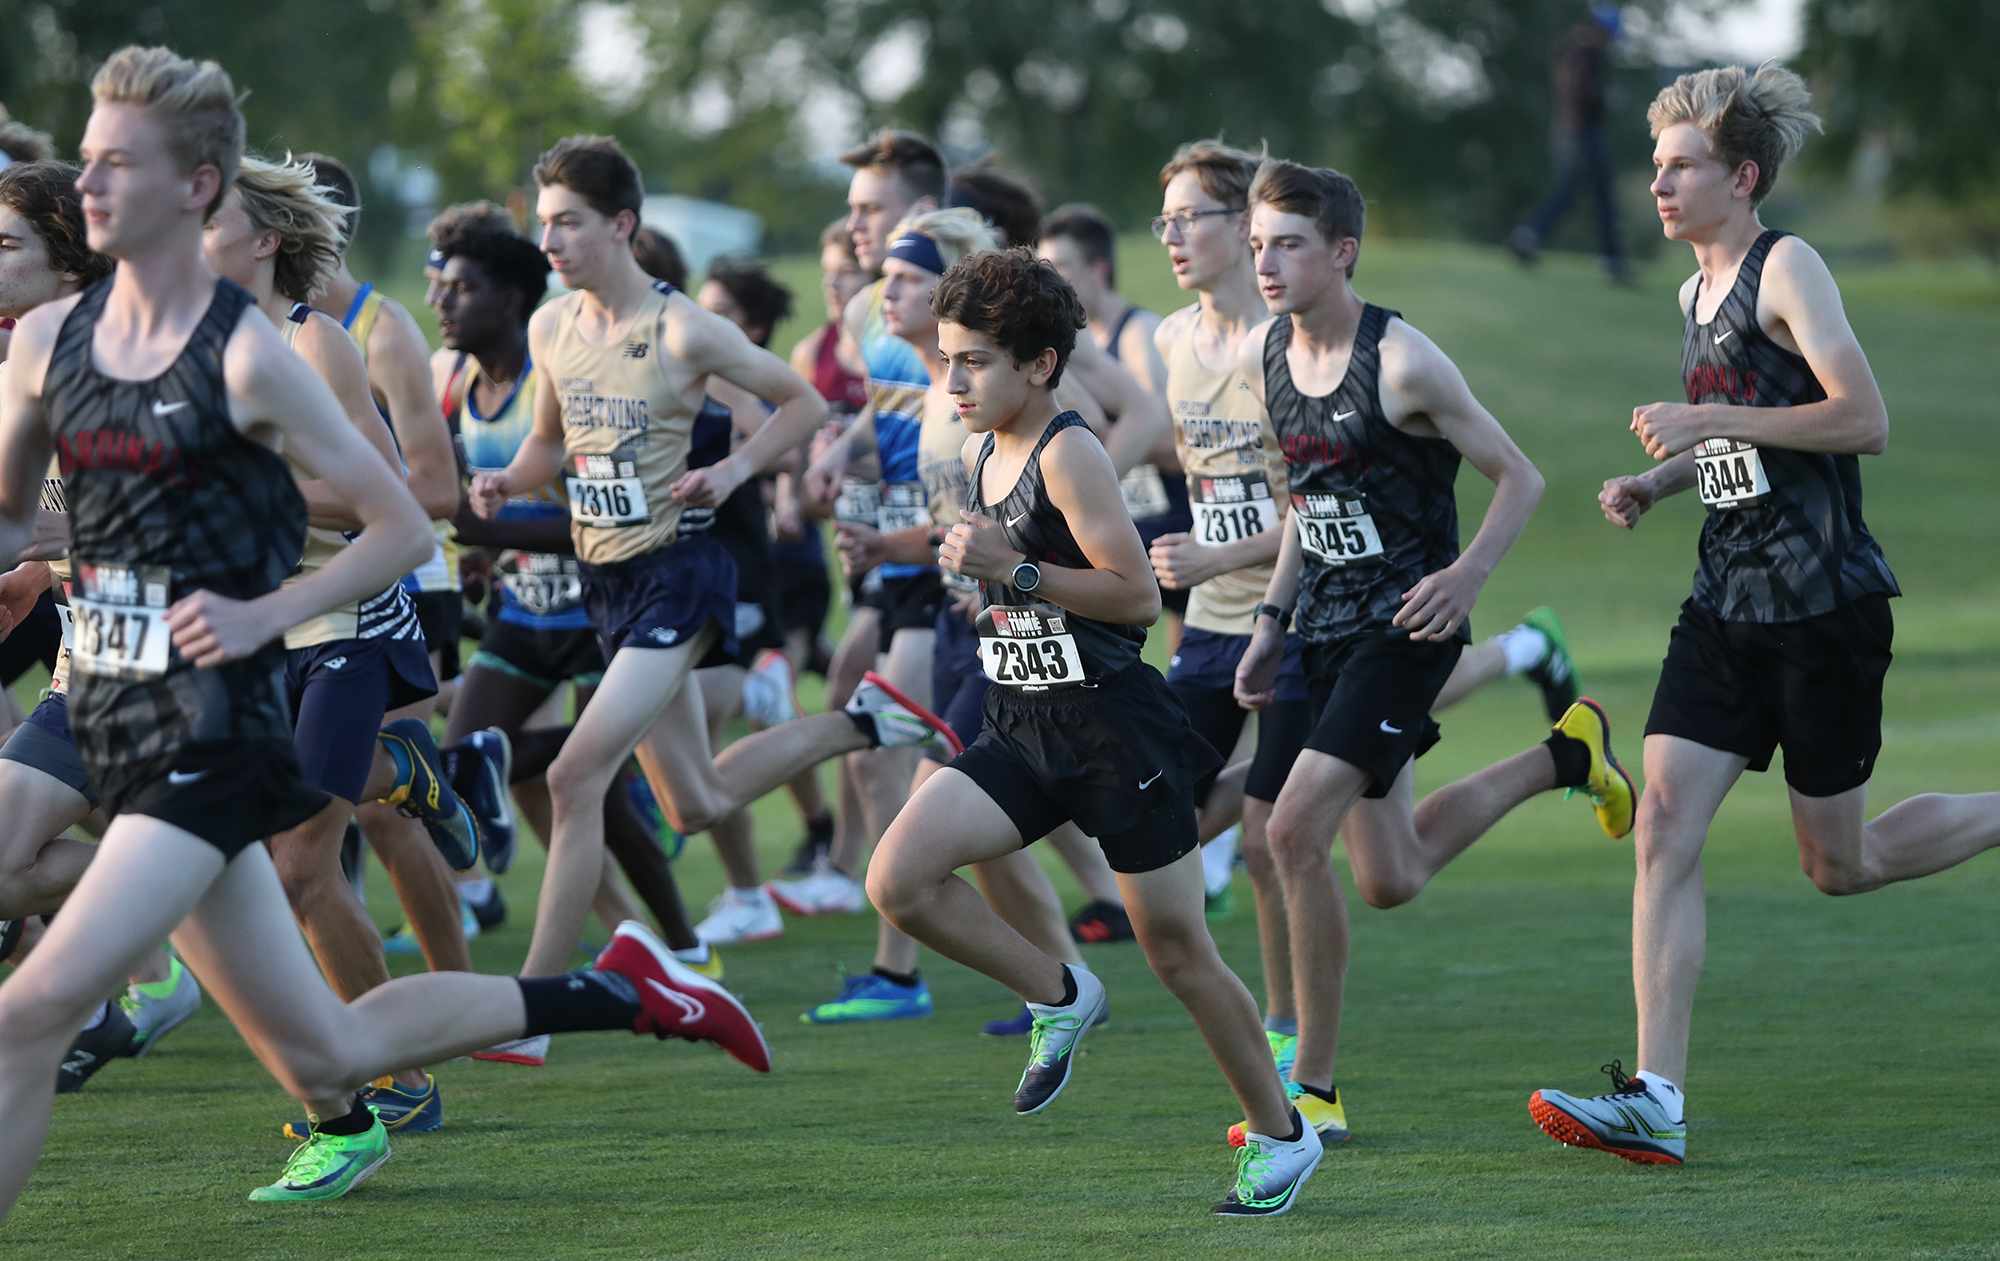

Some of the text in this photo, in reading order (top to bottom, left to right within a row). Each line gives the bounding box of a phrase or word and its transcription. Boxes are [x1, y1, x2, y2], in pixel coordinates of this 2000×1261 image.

[1684, 364, 1758, 404] ARDINALS
[576, 484, 631, 517] 2316
[1305, 499, 1341, 512] TIME
[1201, 504, 1264, 543] 2318
[1007, 610, 1036, 618] PRIME
[1007, 616, 1043, 632] TIME
[992, 639, 1069, 681] 2343
